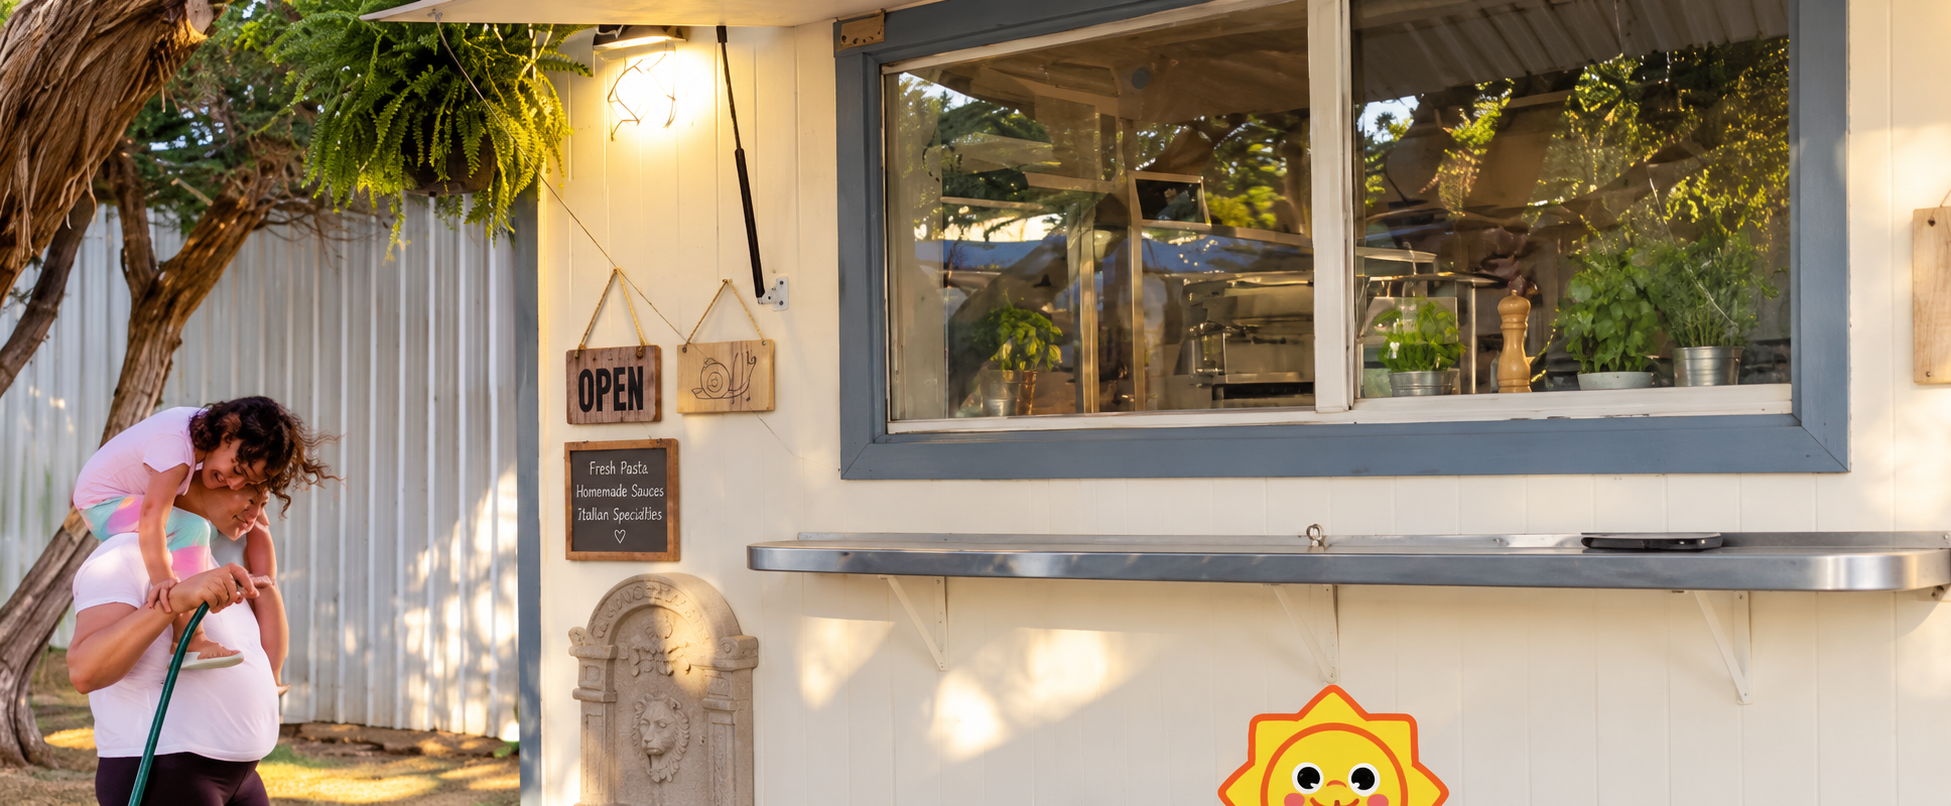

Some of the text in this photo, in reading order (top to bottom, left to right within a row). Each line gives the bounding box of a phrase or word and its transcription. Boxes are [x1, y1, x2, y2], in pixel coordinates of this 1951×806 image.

[578, 366, 644, 412] OPEN
[589, 460, 649, 475] Fresh Pasta
[576, 483, 664, 498] Homemade Sauces
